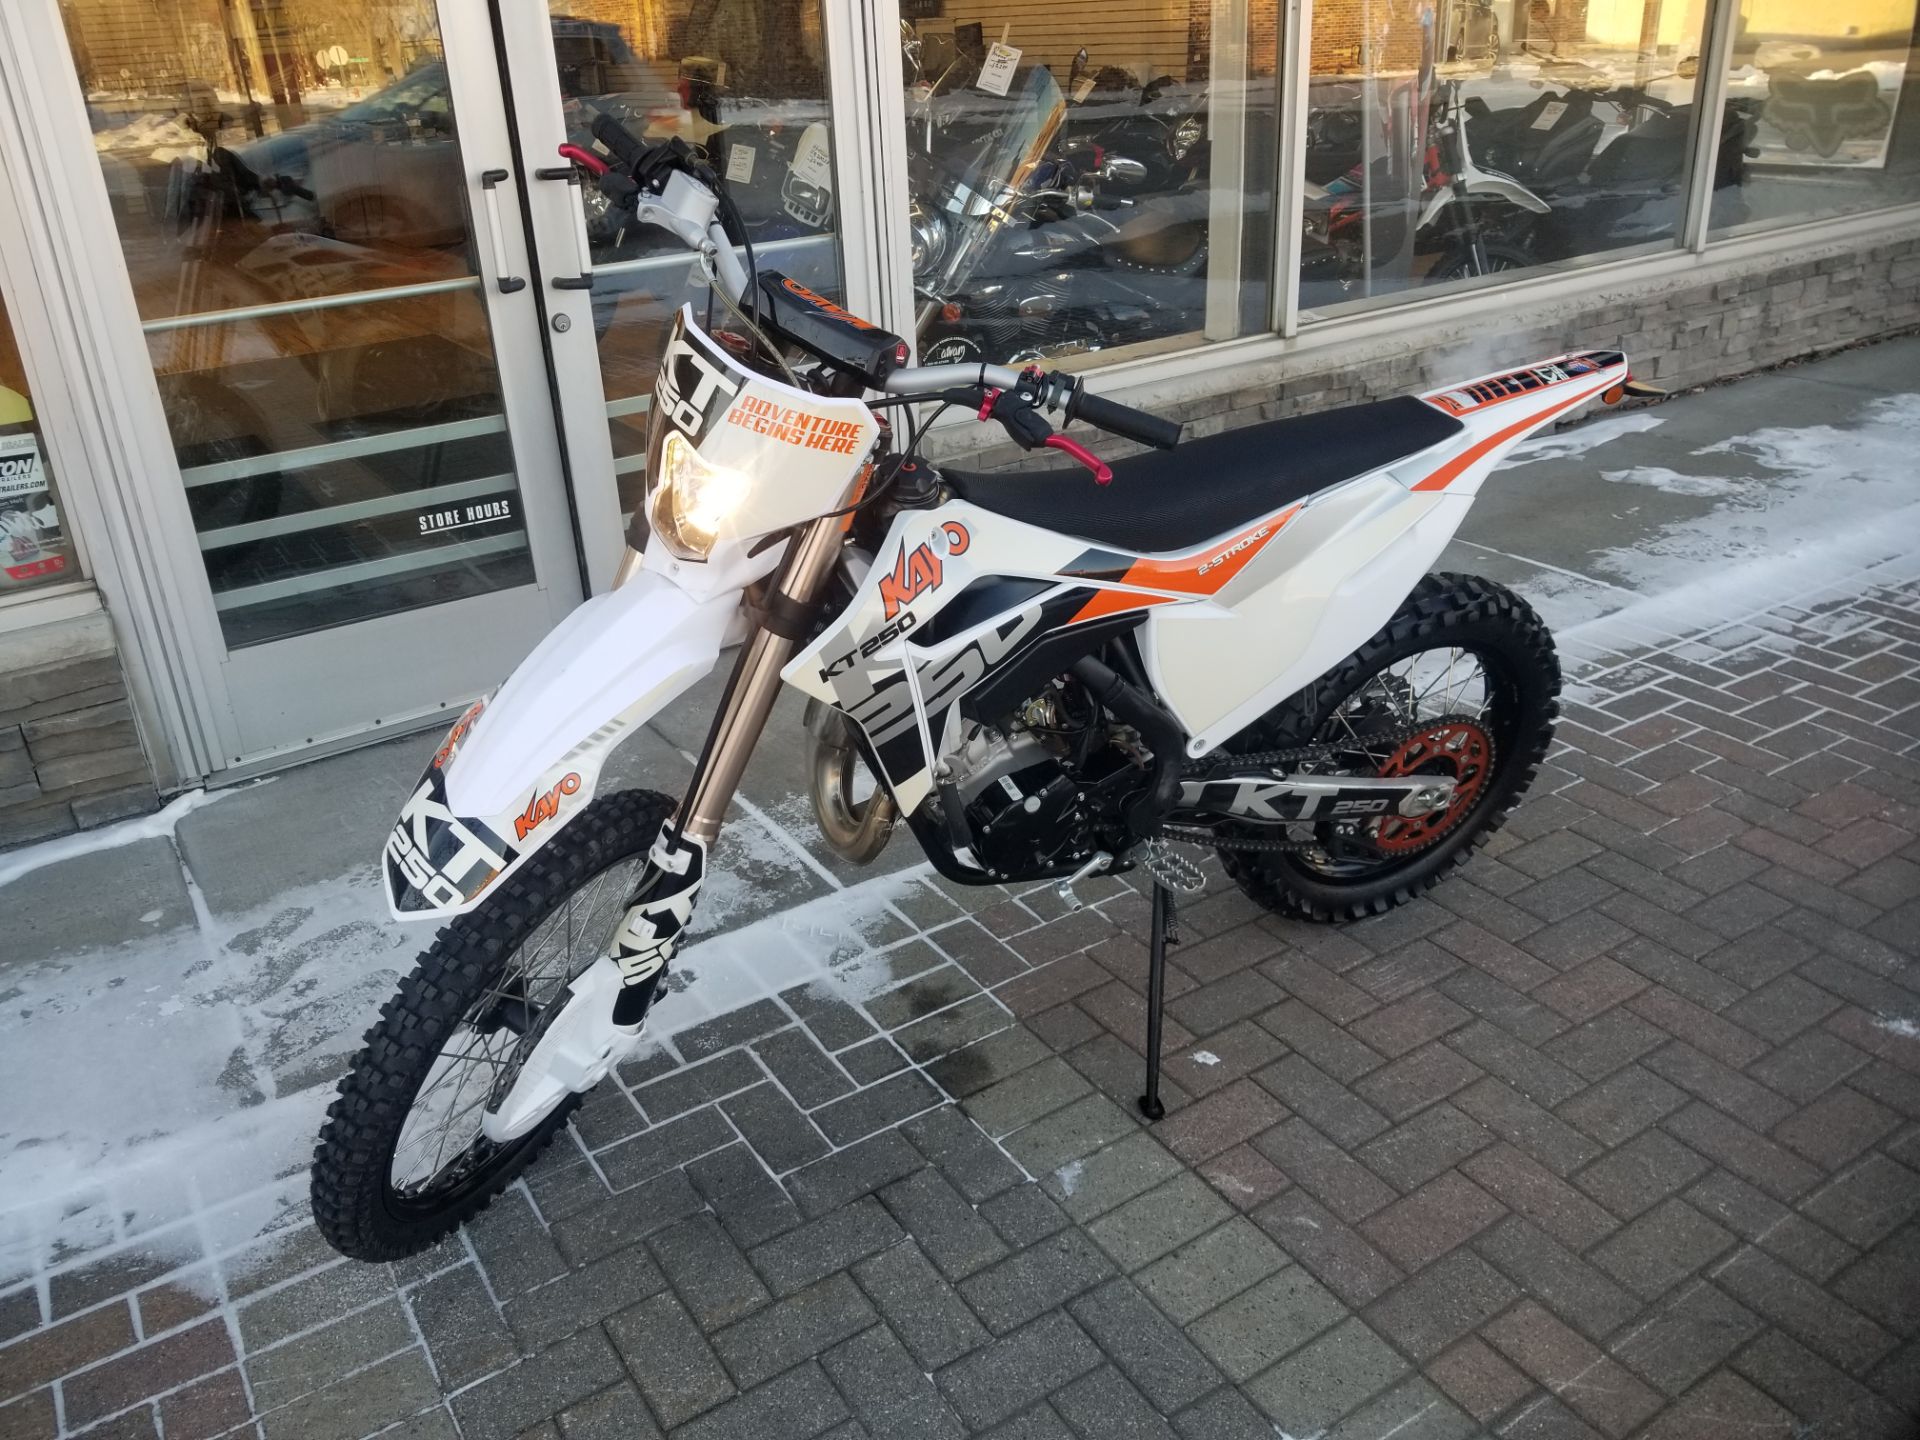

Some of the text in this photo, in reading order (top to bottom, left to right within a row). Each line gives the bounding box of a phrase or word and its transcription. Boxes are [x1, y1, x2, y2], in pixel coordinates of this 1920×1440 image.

[727, 408, 861, 456] BEGINS HERE
[741, 394, 864, 439] ADVENTURE
[418, 500, 510, 531] STORE HOURS
[878, 521, 970, 622] KAYO
[1197, 525, 1270, 576] 2-STROKE
[514, 771, 581, 842] KAYO
[1227, 783, 1390, 820] KT 250
[401, 777, 508, 885] KT
[388, 823, 465, 910] 250
